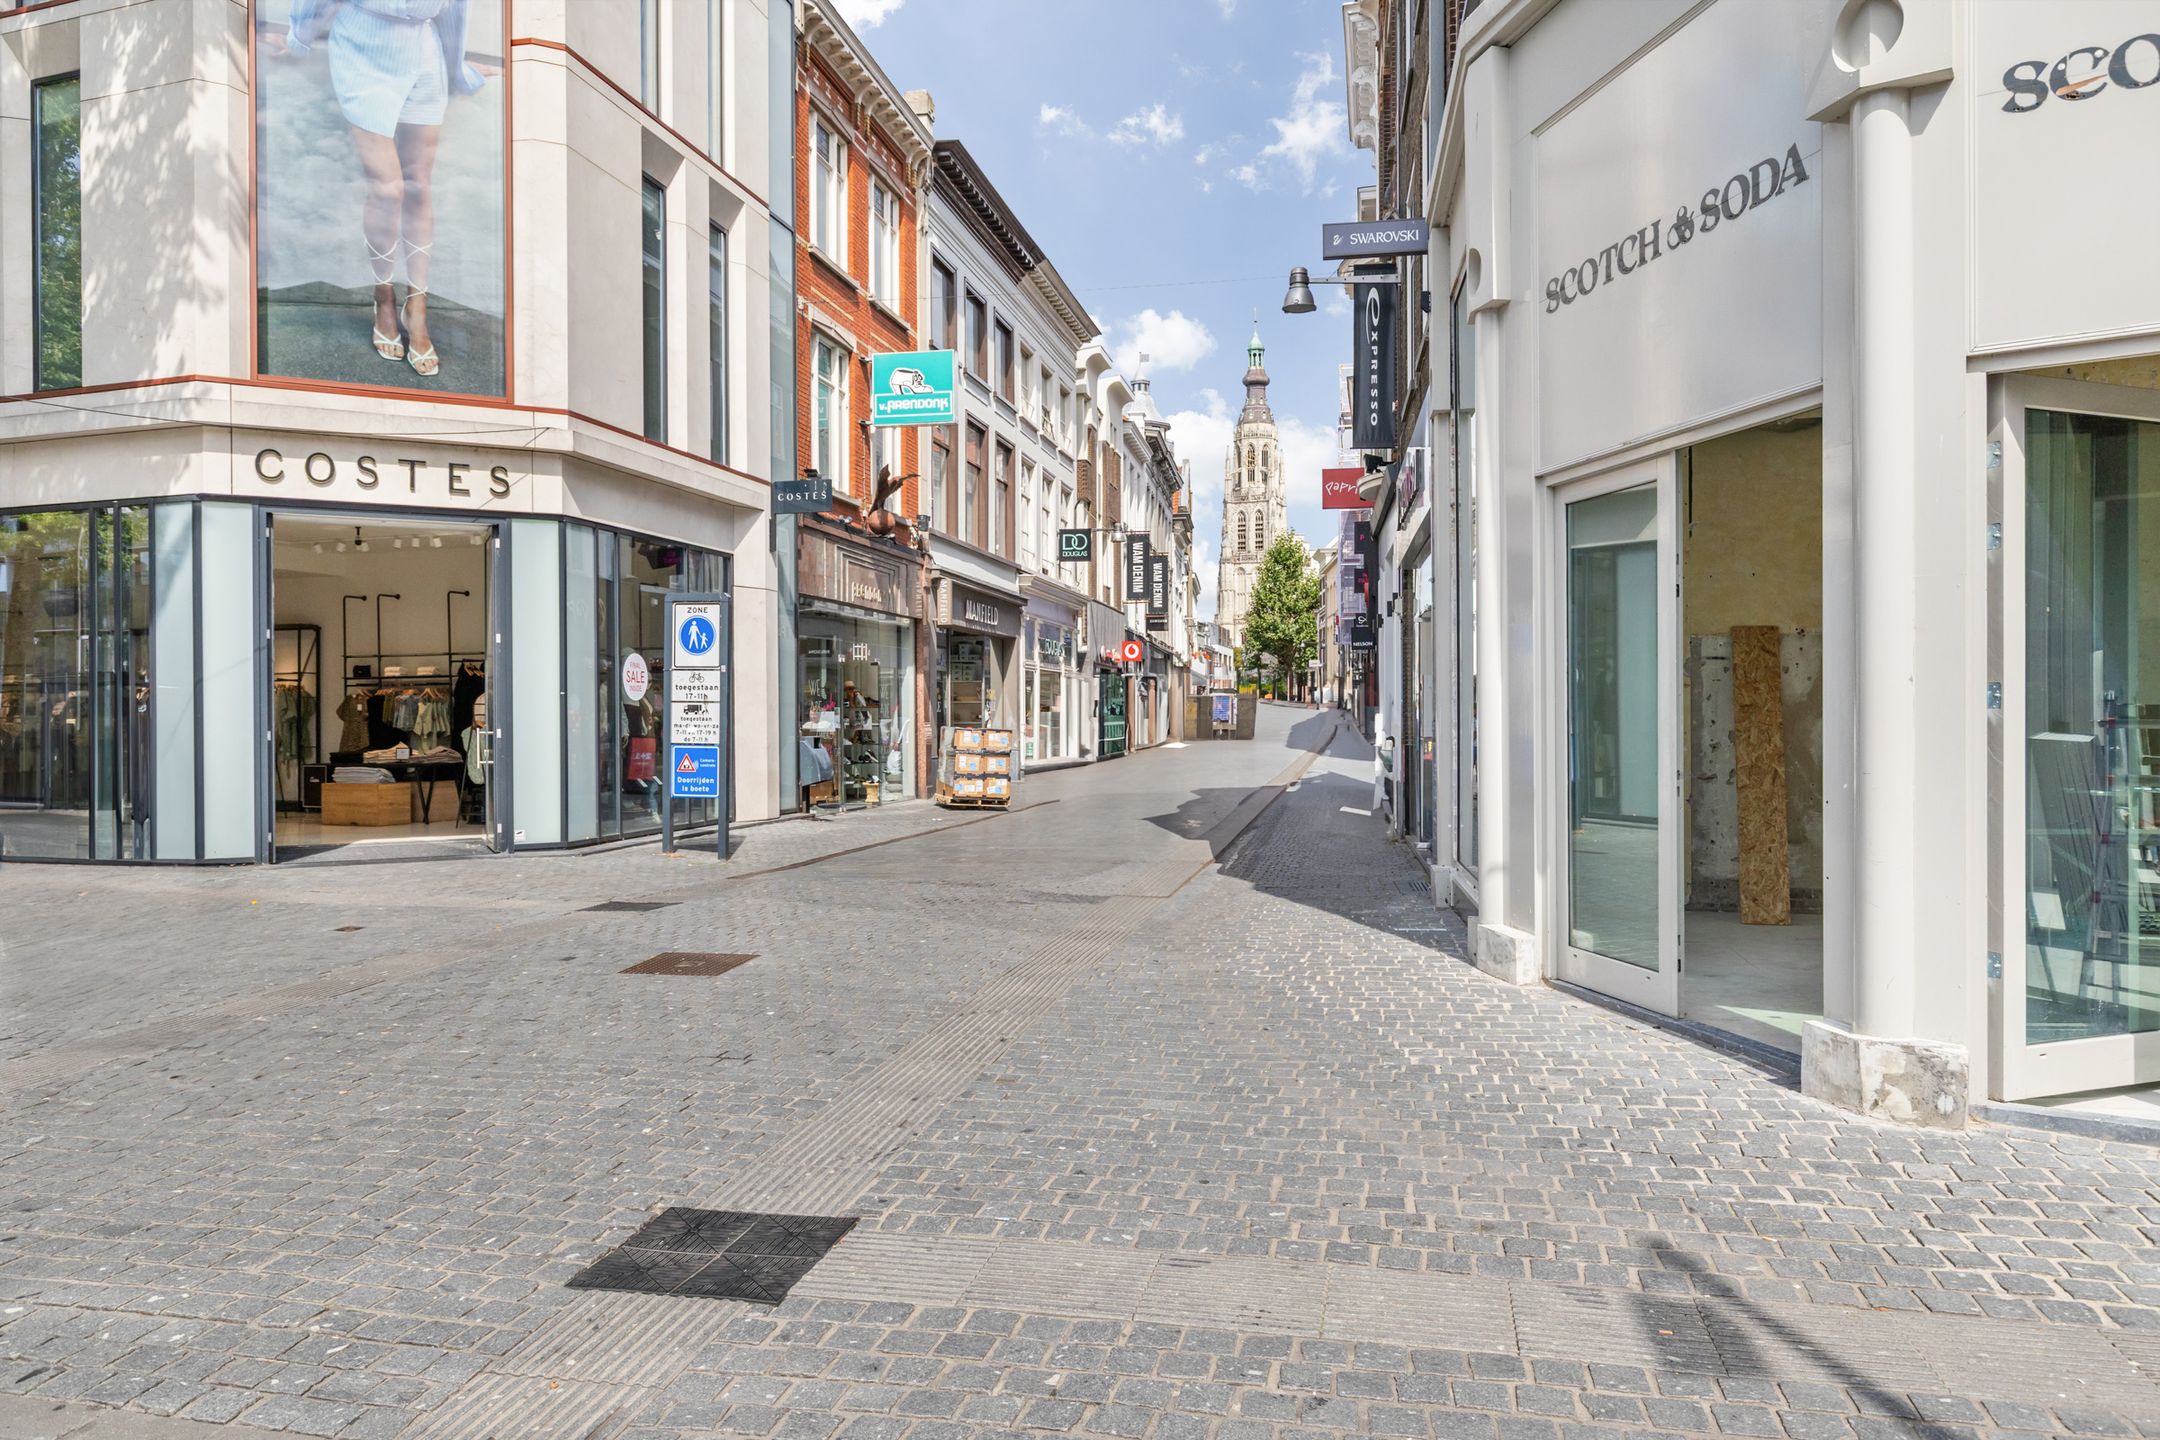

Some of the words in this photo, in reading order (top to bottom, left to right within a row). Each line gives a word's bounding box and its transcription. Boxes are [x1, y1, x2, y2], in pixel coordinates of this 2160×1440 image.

[2001, 33, 2160, 113] SCO
[1350, 229, 1419, 245] SWAROVSKI
[1546, 219, 1662, 313] SCOTCH
[1667, 205, 1695, 250] &
[1700, 142, 1809, 232] SODA
[255, 449, 510, 498] COSTES
[777, 491, 827, 501] COSTES
[1132, 541, 1144, 563] WAM
[1132, 566, 1144, 593] DENIM
[1152, 562, 1163, 582] WAM
[940, 578, 948, 623] MANFIELD
[1152, 583, 1163, 608] DENIM
[965, 599, 999, 626] MANFIELD
[626, 670, 645, 683] SALE
[675, 684, 719, 692] toegestaan
[677, 777, 715, 785] Doorrijden
